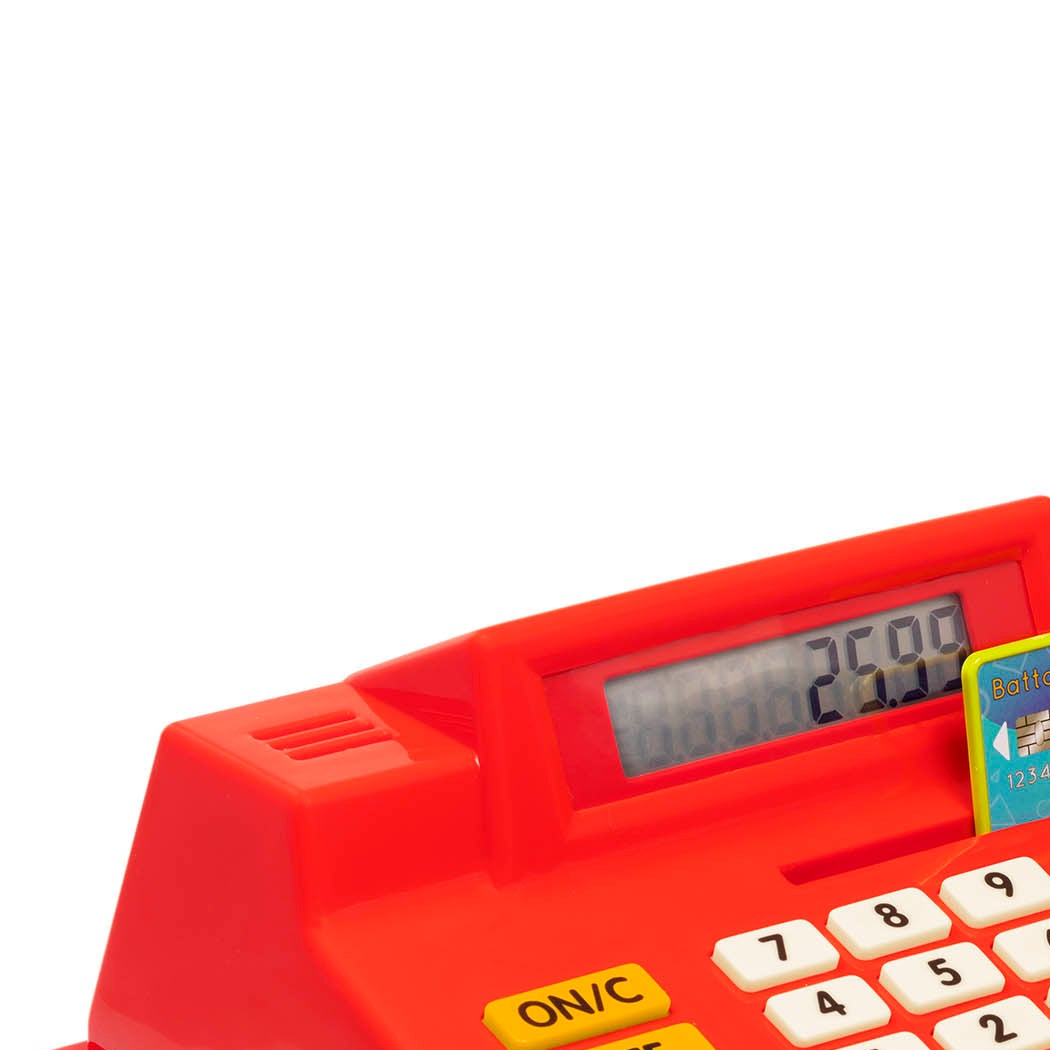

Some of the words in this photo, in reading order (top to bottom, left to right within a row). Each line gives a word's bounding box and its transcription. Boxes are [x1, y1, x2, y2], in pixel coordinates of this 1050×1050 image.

[984, 871, 1014, 898] 9
[874, 903, 909, 928] 8
[758, 933, 788, 962] 7
[927, 958, 962, 986] 5
[518, 976, 644, 1028] ON/C
[816, 990, 847, 1016] 4
[978, 1014, 1018, 1044] 2
